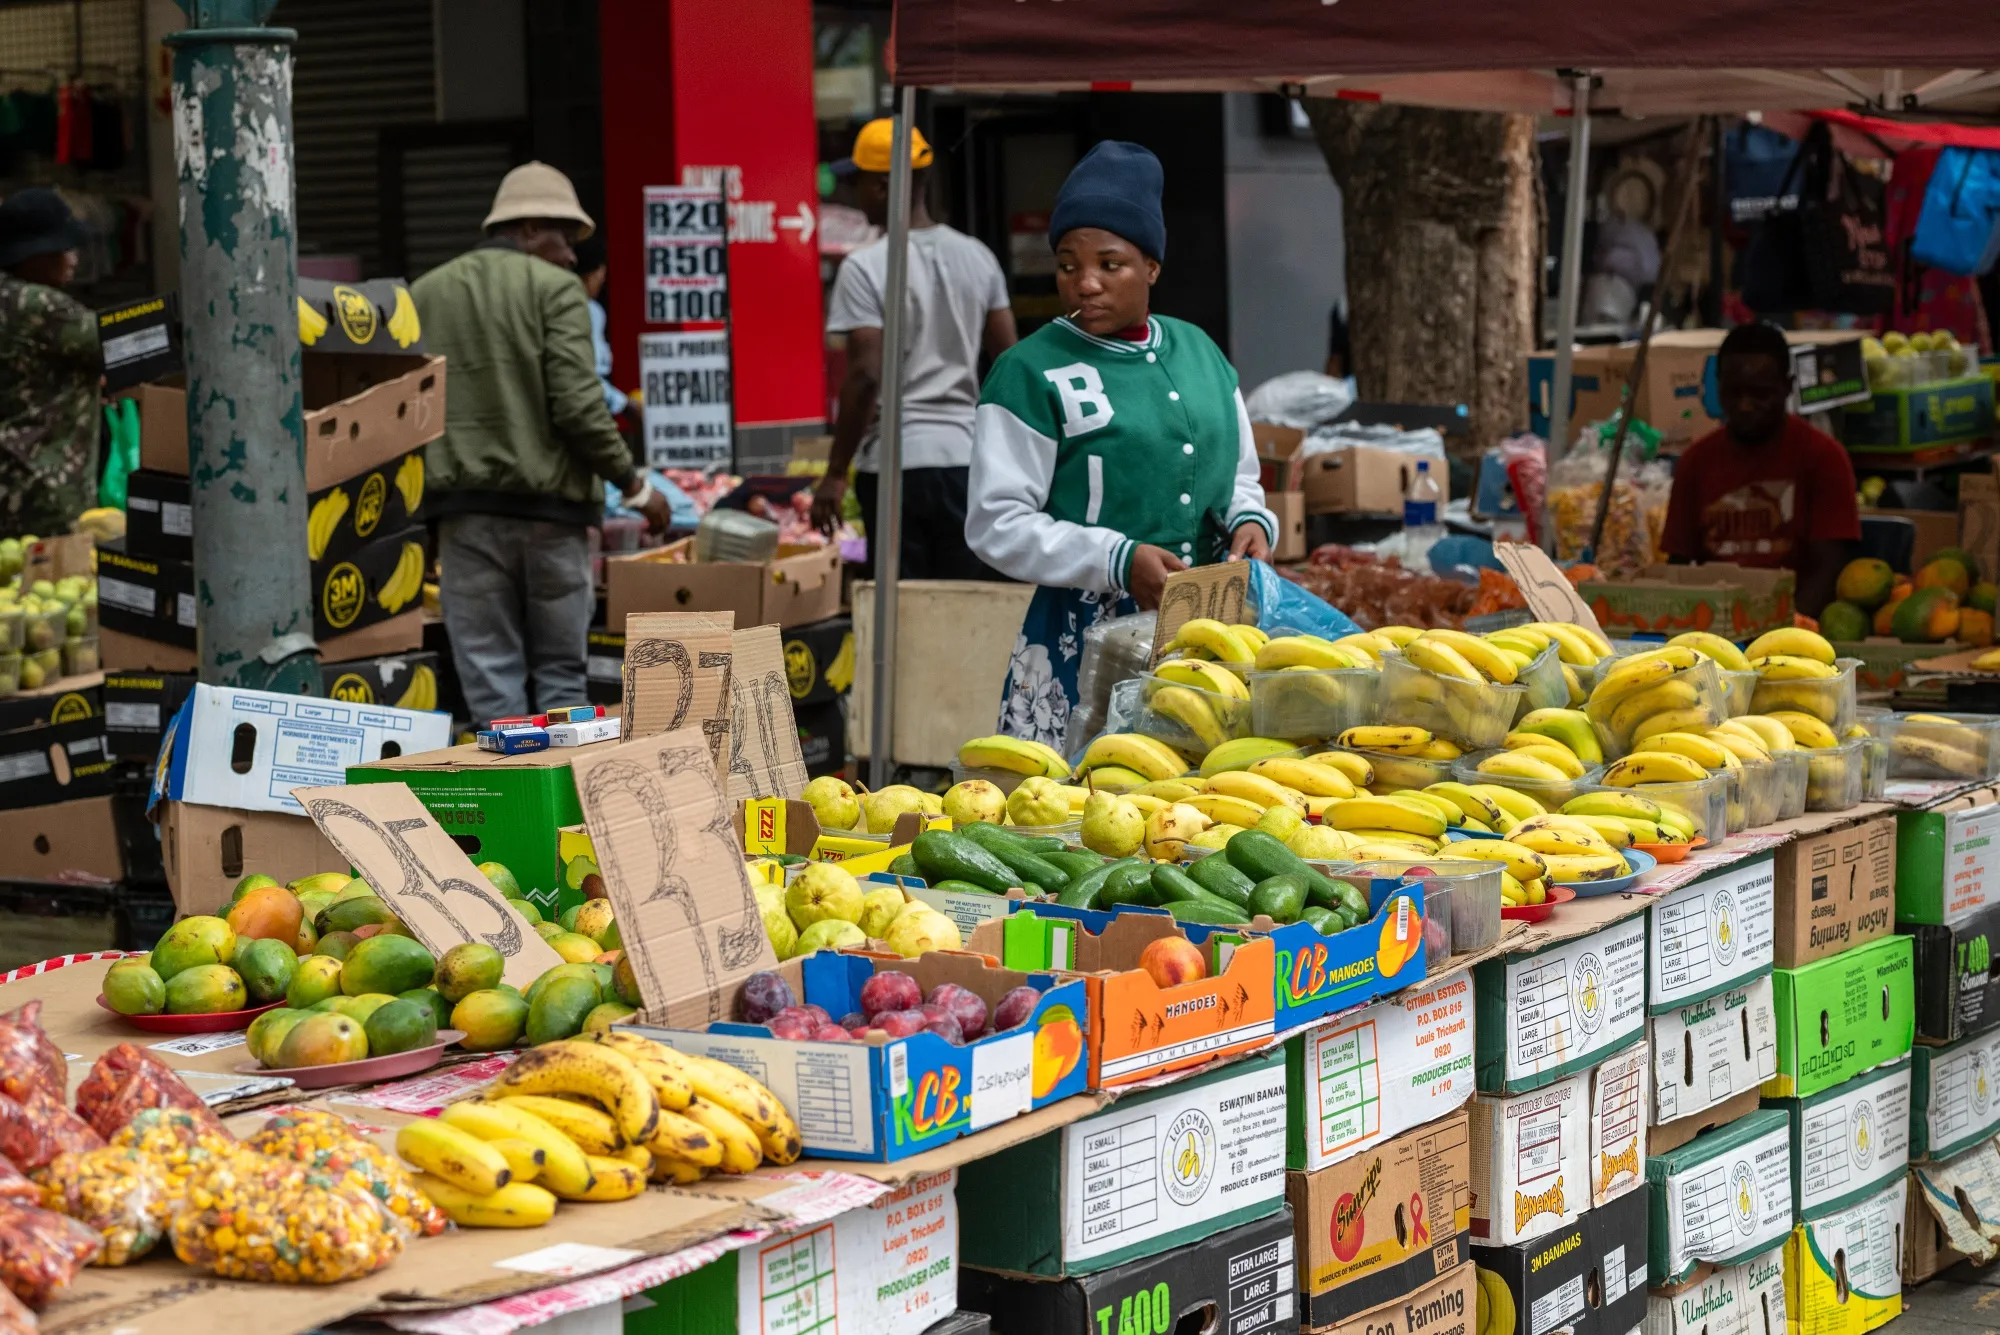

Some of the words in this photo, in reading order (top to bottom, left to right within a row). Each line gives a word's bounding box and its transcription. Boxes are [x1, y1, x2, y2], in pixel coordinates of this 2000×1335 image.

[650, 203, 726, 228] R20
[650, 248, 726, 276] R50
[115, 299, 165, 323] BANANAS
[650, 291, 727, 320] R100
[647, 369, 730, 406] REPAIR
[1043, 362, 1115, 438] B
[654, 423, 691, 440] FOR
[696, 422, 726, 438] ALL
[112, 554, 159, 575] BANANAS
[330, 574, 357, 601] 3M
[235, 700, 249, 708] Extra
[250, 703, 268, 711] Large
[304, 708, 321, 717] Large
[363, 716, 386, 724] Medium
[760, 809, 774, 839] ZZ2
[1666, 908, 1681, 919] SMALL
[1811, 903, 1836, 920] Piesangs
[1858, 907, 1888, 933] AnSon
[1663, 926, 1678, 936] SMALL
[1810, 920, 1852, 950] Farming
[1604, 941, 1626, 956] ESWATINI
[1664, 941, 1682, 952] MEDIUM
[1741, 948, 1755, 958] PRODUCE
[1576, 956, 1601, 981] LUBOMBO
[1664, 958, 1681, 969] LARGE
[1276, 943, 1328, 1010] RCB
[1329, 956, 1375, 985] MANGOES
[1522, 975, 1538, 987] SMALL
[1670, 973, 1687, 984] LARGE
[1406, 993, 1436, 1011] CITIMBA
[1438, 981, 1467, 1000] ESTATES
[1519, 994, 1535, 1006] SMALL
[1165, 993, 1217, 1018] MANGOES
[1417, 1014, 1431, 1026] P.O.
[1432, 1007, 1448, 1021] BOX
[1449, 1001, 1462, 1015] 815
[1681, 999, 1716, 1027] Umbhaba
[1724, 991, 1747, 1011] Estates
[1609, 1011, 1625, 1025] PRODUCE
[1416, 1032, 1435, 1046] Louis
[1437, 1019, 1466, 1040] Trichardt
[1521, 1028, 1538, 1041] LARGE
[1147, 1034, 1232, 1064] TOMAHAWK
[1322, 1047, 1338, 1059] EXTRA
[1338, 1041, 1355, 1053] LARGE
[1434, 1043, 1452, 1059] 0920
[1527, 1045, 1544, 1058] LARGE
[1662, 1048, 1676, 1060] SINGLE
[1323, 1060, 1333, 1069] 230
[1334, 1058, 1344, 1067] mm
[1344, 1053, 1354, 1063] Plus
[1411, 1066, 1451, 1087] PRODUCER
[1453, 1055, 1472, 1072] CODE
[1331, 1081, 1348, 1094] LARGE
[1438, 1079, 1452, 1094] 110
[1614, 1081, 1624, 1092] LARGE
[1220, 1092, 1256, 1113] ESWATINI
[1336, 1094, 1345, 1102] mm
[1345, 1089, 1356, 1099] Plus
[1506, 1097, 1543, 1119] NATURES
[1544, 1087, 1572, 1107] CHOICE
[1603, 1103, 1613, 1113] LARGE
[1169, 1113, 1210, 1142] LUBOMBO
[1242, 1124, 1251, 1133] Box
[1331, 1119, 1352, 1133] MEDIUM
[1603, 1124, 1628, 1142] PRE-COOLED
[1810, 1121, 1824, 1131] SMALL
[1094, 1137, 1115, 1149] SMALL
[1326, 1135, 1336, 1144] 165
[1336, 1132, 1346, 1140] mm
[1346, 1127, 1357, 1137] Plus
[1088, 1158, 1110, 1172] SMALL
[1601, 1136, 1639, 1194] BANANAS
[1807, 1166, 1821, 1176] LARGE
[916, 1168, 952, 1195] ESTATES
[1088, 1177, 1114, 1193] MEDIUM
[1220, 1178, 1249, 1194] PRODUCE
[1250, 1174, 1259, 1184] OF
[1689, 1182, 1702, 1193] SMALL
[1811, 1179, 1826, 1190] LARGE
[1088, 1199, 1111, 1214] LARGE
[1336, 1156, 1382, 1242] Sunripe
[1515, 1175, 1564, 1236] BANANAS
[1685, 1200, 1700, 1211] SMALL
[887, 1212, 905, 1228] P.O.
[907, 1204, 925, 1220] BOX
[1686, 1214, 1705, 1226] MEDIUM
[1762, 1214, 1778, 1226] PRODUCE
[1094, 1219, 1117, 1234] LARGE
[884, 1234, 908, 1252] Louis
[1688, 1231, 1705, 1243] LARGE
[906, 1246, 929, 1265] 0920
[1437, 1243, 1453, 1259] EXTRA
[1531, 1258, 1542, 1273] 3M
[1543, 1232, 1582, 1266] BANANAS
[1231, 1258, 1254, 1276] EXTRA
[1255, 1248, 1278, 1269] LARGE
[1319, 1270, 1341, 1285] PRODUCE
[1348, 1254, 1381, 1273] MOZAMBIQUE
[1438, 1255, 1455, 1270] LARGE
[877, 1269, 928, 1301] PRODUCER
[929, 1255, 951, 1277] CODE
[1243, 1279, 1270, 1301] LARGE
[1681, 1279, 1734, 1325] Umbhaba
[1748, 1261, 1780, 1290] Estates
[1405, 1288, 1464, 1333] Farming
[1236, 1308, 1269, 1334] MEDIUM
